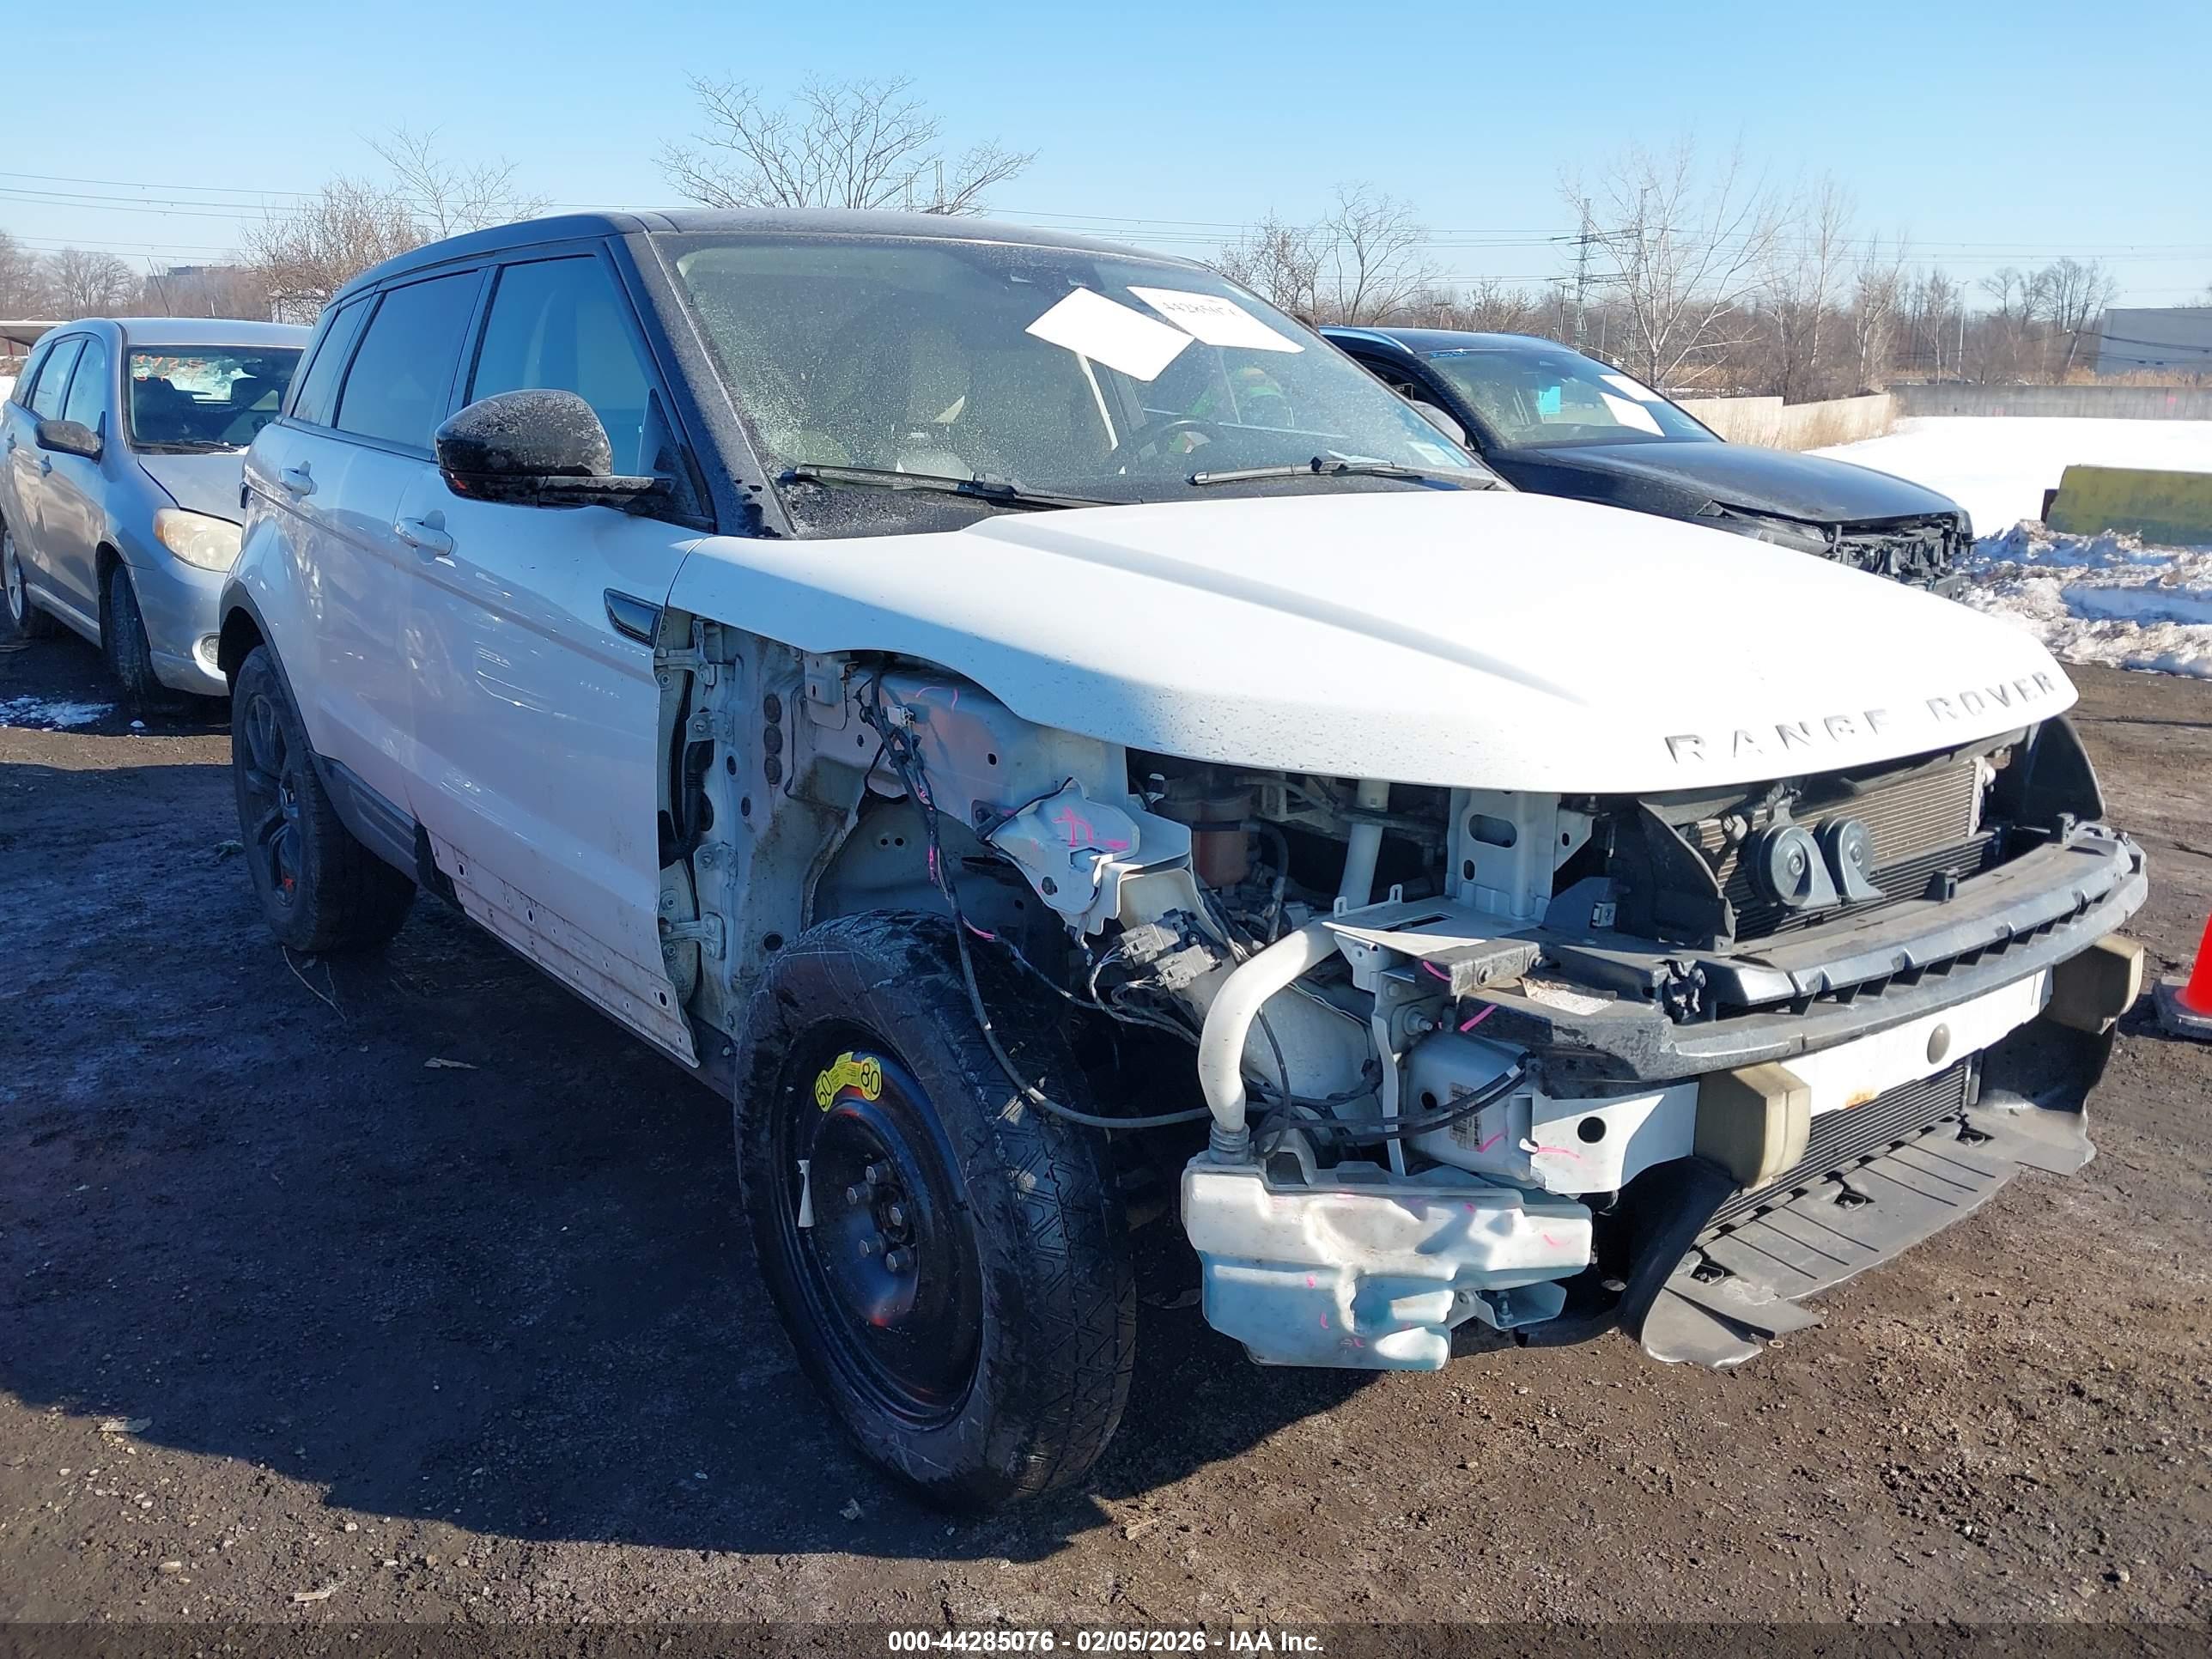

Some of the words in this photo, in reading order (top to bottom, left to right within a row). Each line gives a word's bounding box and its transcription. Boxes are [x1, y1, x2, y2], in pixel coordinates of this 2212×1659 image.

[1664, 708, 1890, 764] RANGE
[1925, 671, 2057, 723] ROVER
[816, 1073, 833, 1108] 50
[861, 1063, 880, 1096] 80
